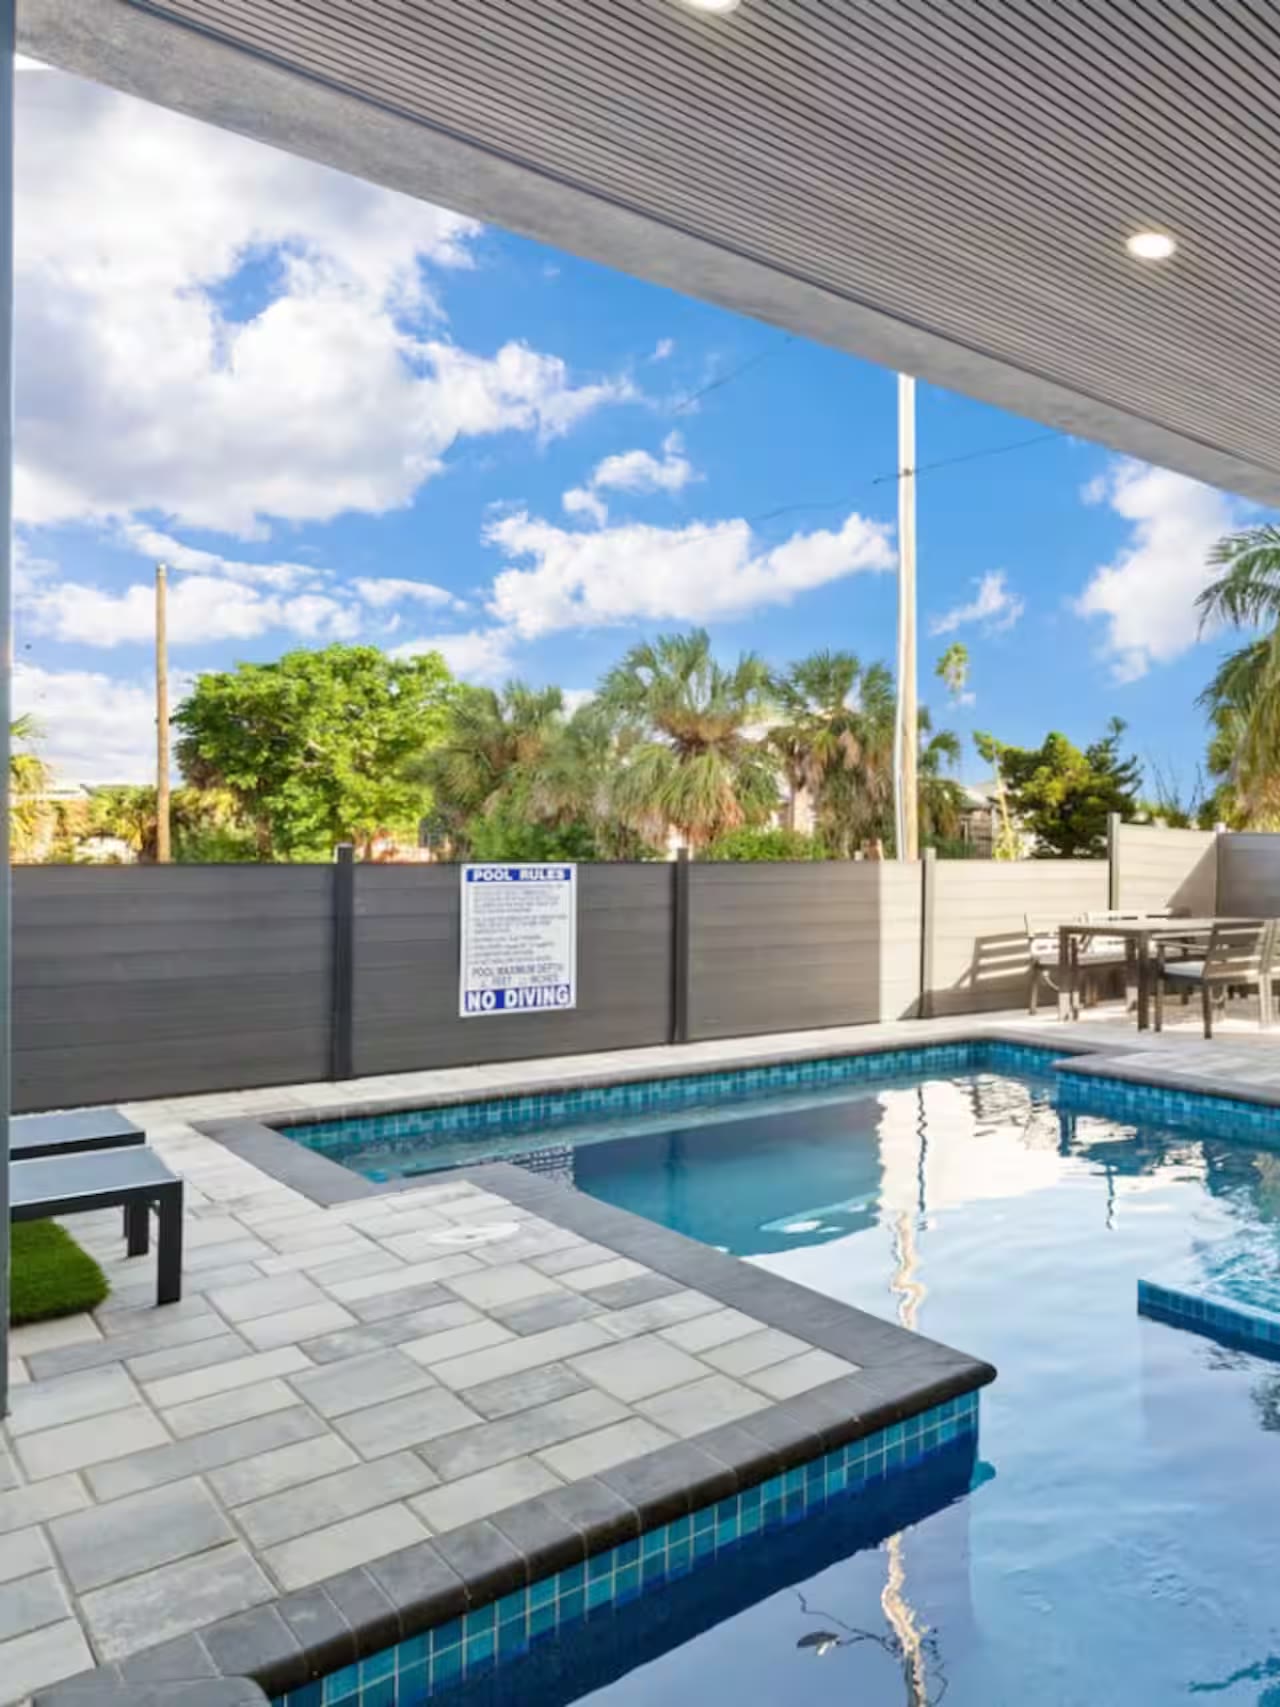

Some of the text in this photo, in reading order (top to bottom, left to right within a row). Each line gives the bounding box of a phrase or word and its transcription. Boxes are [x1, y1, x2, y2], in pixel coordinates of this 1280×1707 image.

[474, 868, 564, 881] POOL RULES
[467, 985, 570, 1011] NO DIVING
